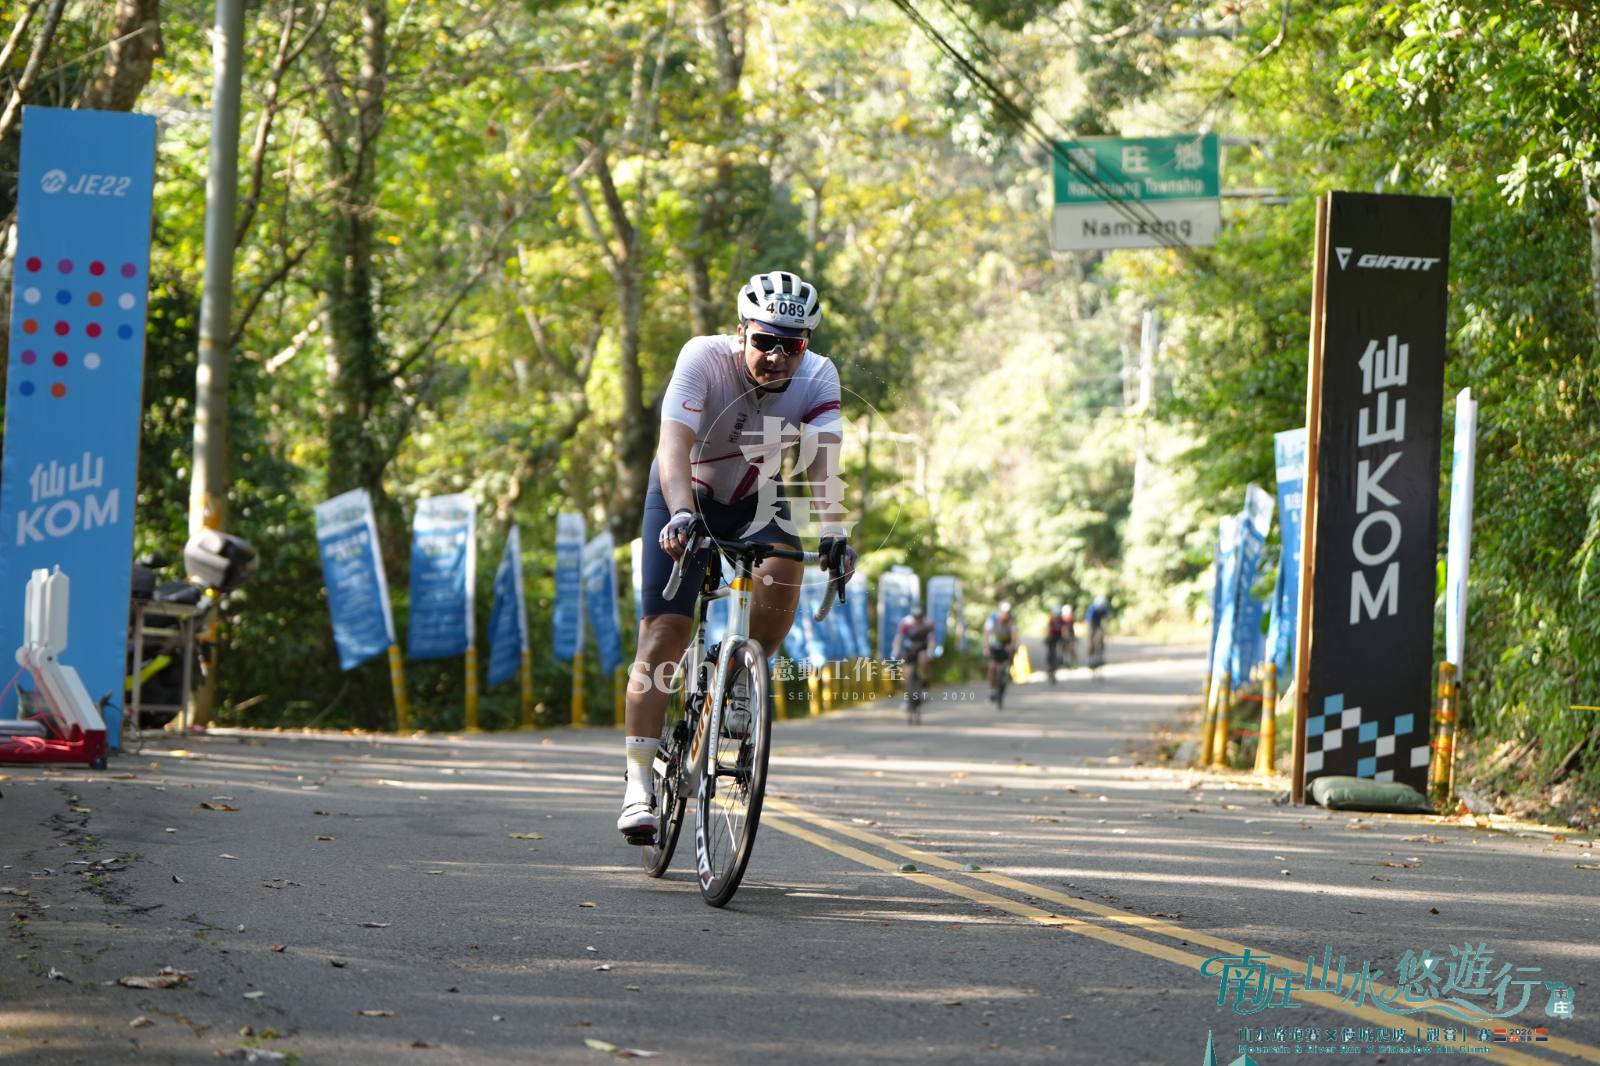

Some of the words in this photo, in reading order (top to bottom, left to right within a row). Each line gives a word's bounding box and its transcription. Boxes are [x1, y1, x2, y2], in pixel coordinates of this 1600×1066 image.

[68, 174, 132, 197] JE22
[1356, 253, 1441, 271] GIANT
[29, 450, 104, 502] 仙山
[16, 488, 120, 546] KOM
[1349, 452, 1403, 625] KOM
